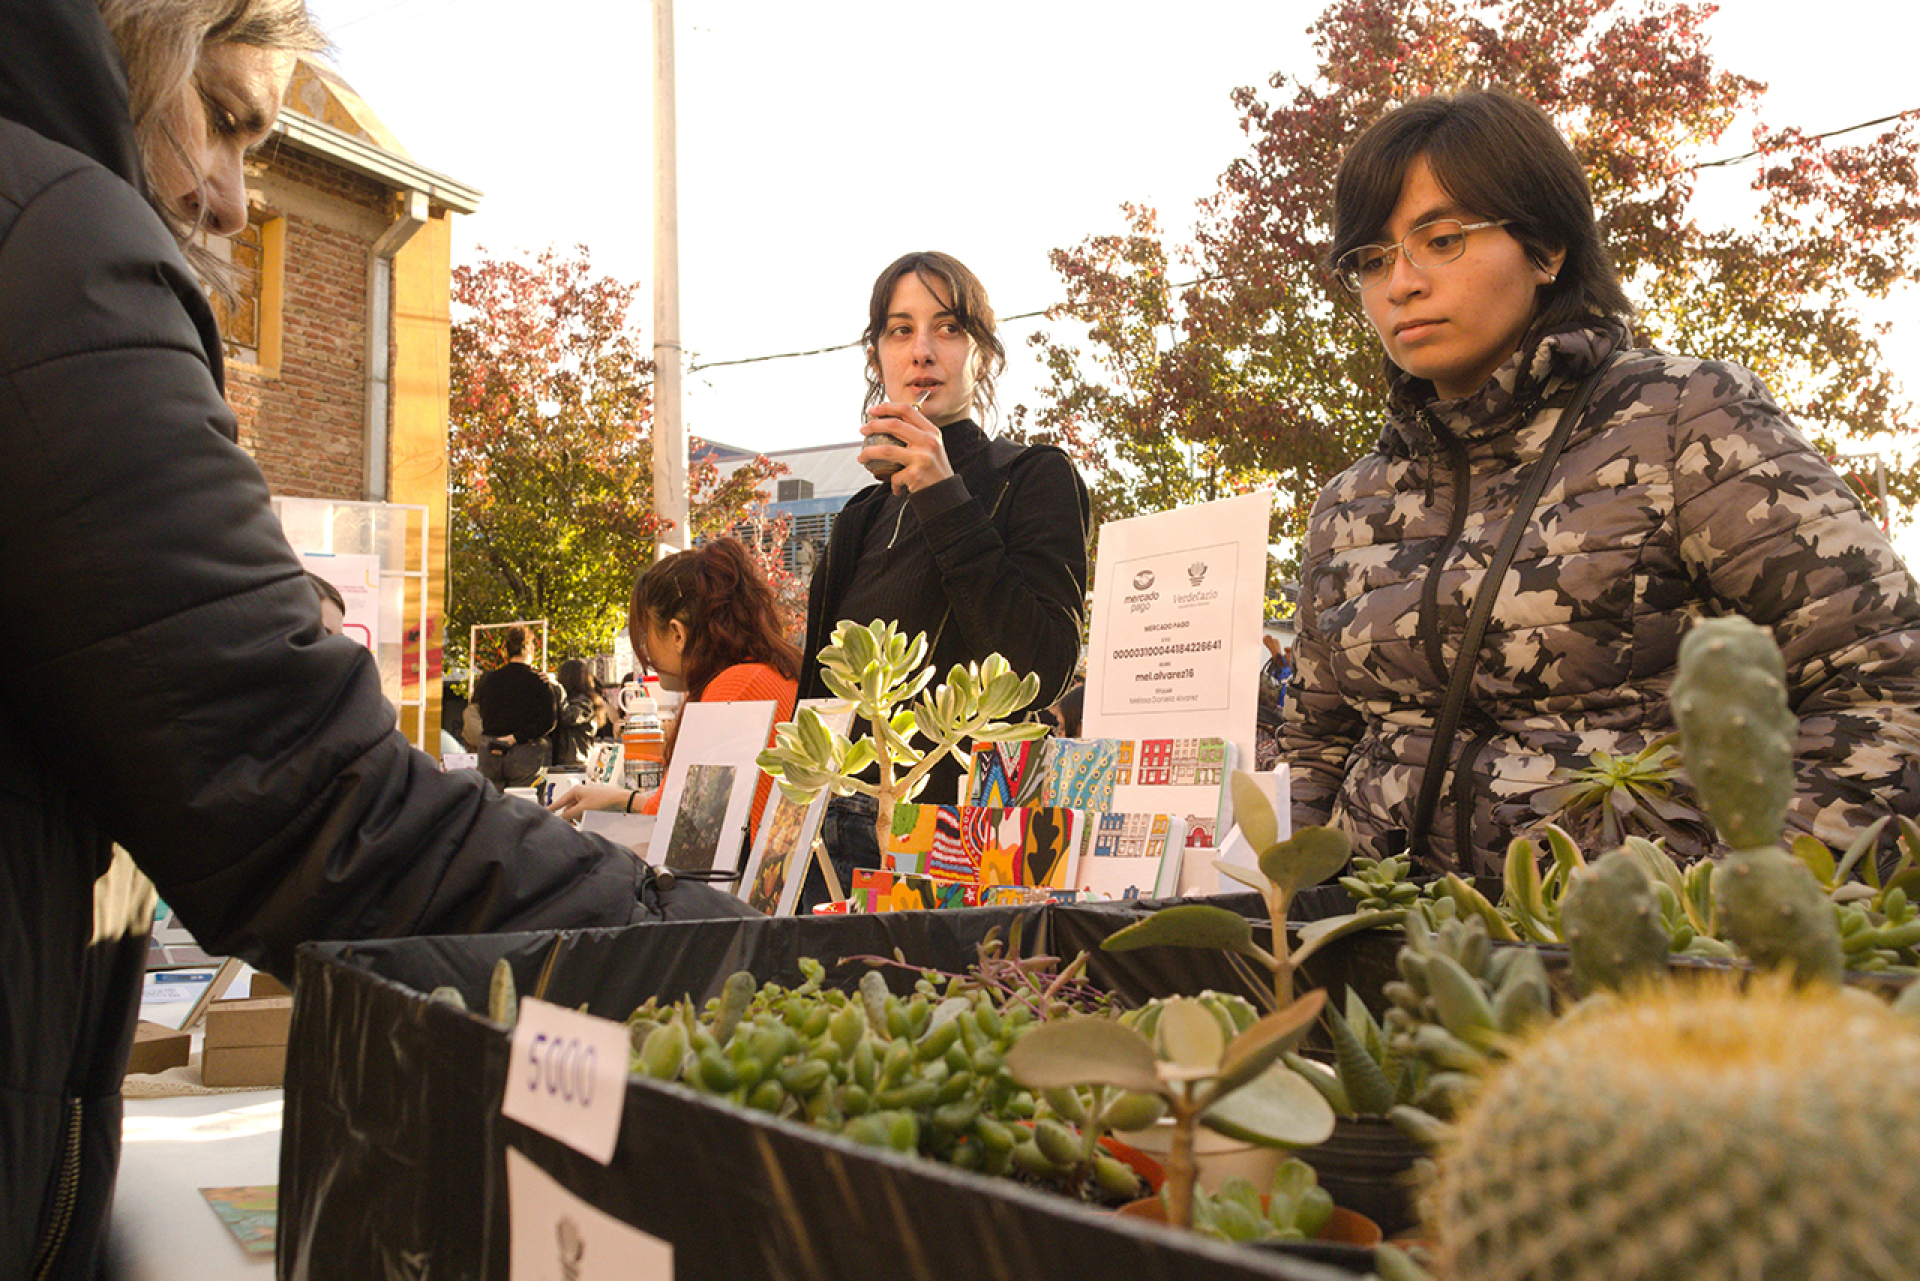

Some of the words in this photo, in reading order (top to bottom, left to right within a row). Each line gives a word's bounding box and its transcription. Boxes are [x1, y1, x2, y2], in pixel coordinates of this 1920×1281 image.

[1124, 591, 1160, 603] mercado
[1130, 602, 1151, 613] pago
[1144, 623, 1172, 632] MERCADO
[1173, 620, 1190, 629] PAGO
[1135, 668, 1195, 681] mel.alvarez16
[1176, 694, 1199, 702] Alvarez
[528, 1034, 598, 1108] 5000
